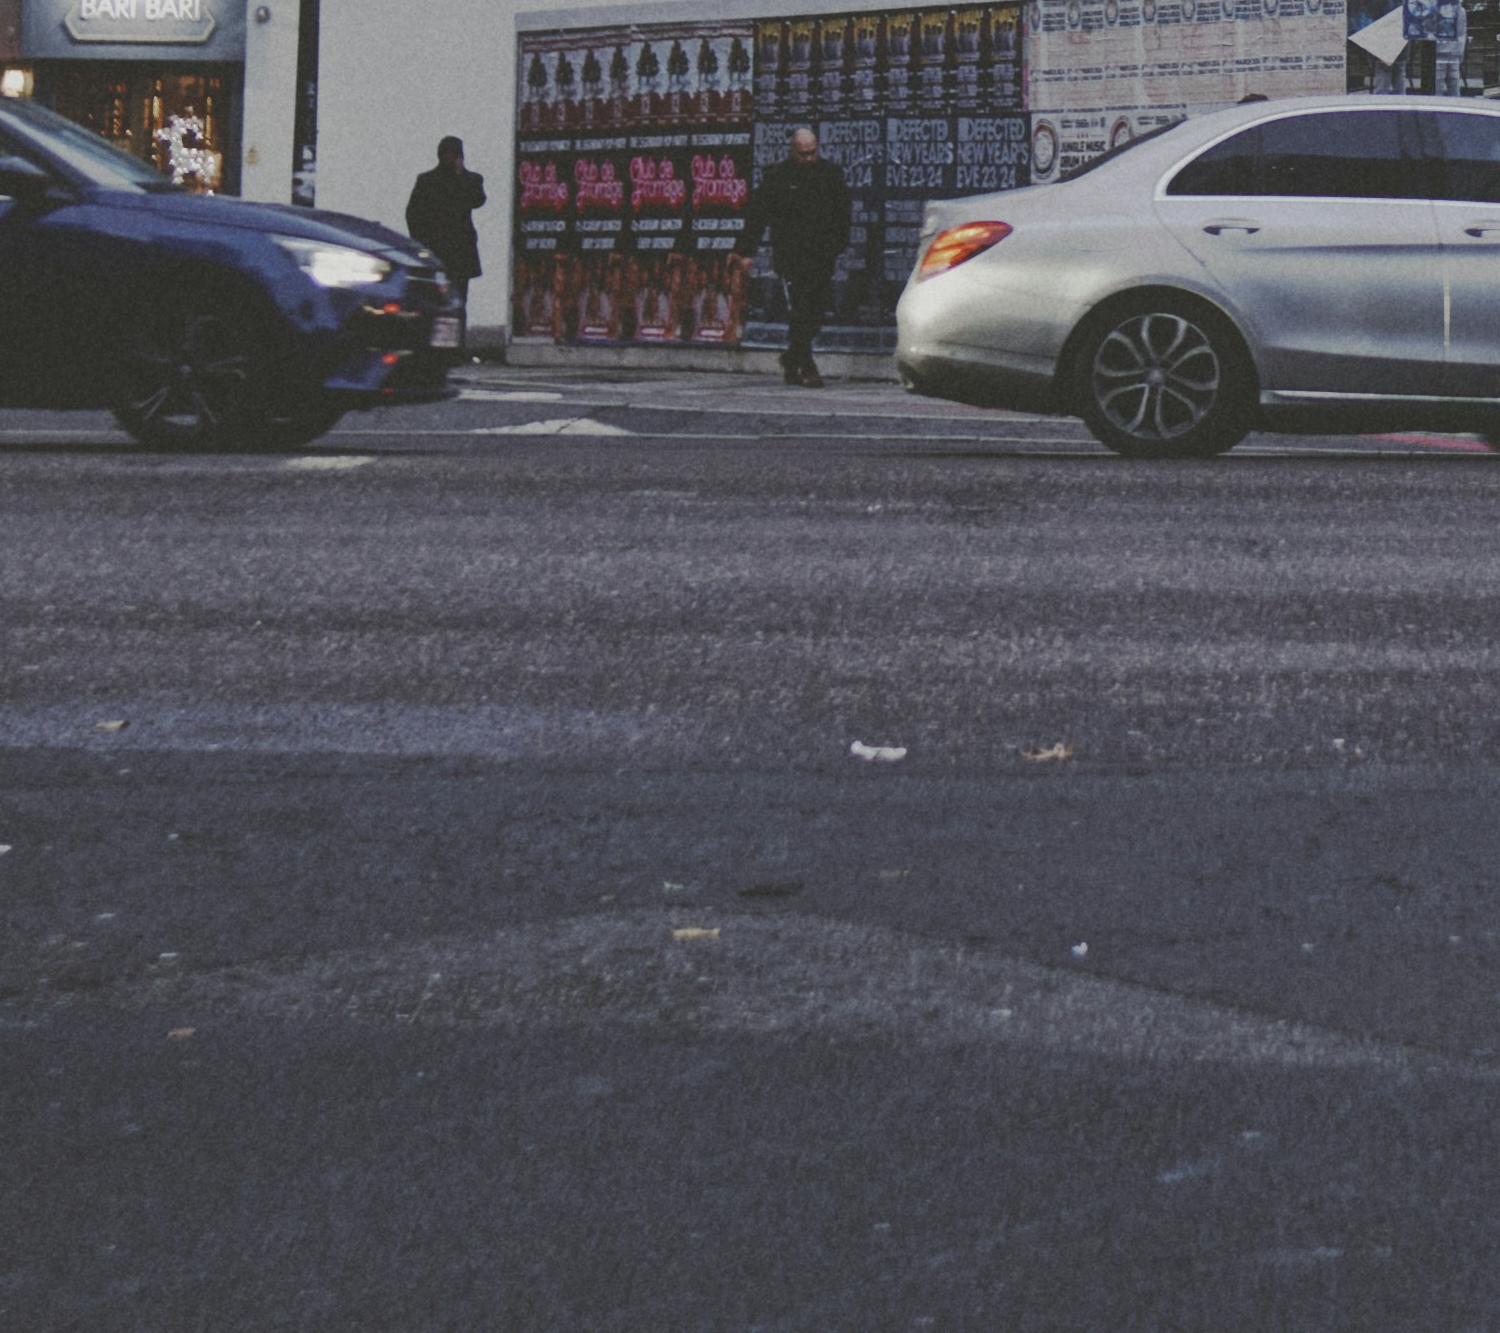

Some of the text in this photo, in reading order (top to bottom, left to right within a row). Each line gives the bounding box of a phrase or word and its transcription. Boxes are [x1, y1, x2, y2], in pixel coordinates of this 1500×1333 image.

[827, 120, 880, 142] DEFECTED
[897, 118, 949, 141] DEFECTED
[968, 118, 1025, 141] DEFECTED
[887, 142, 911, 164] NEW
[957, 142, 984, 165] NEW
[886, 165, 908, 187] EVE
[956, 165, 980, 188] EVE
